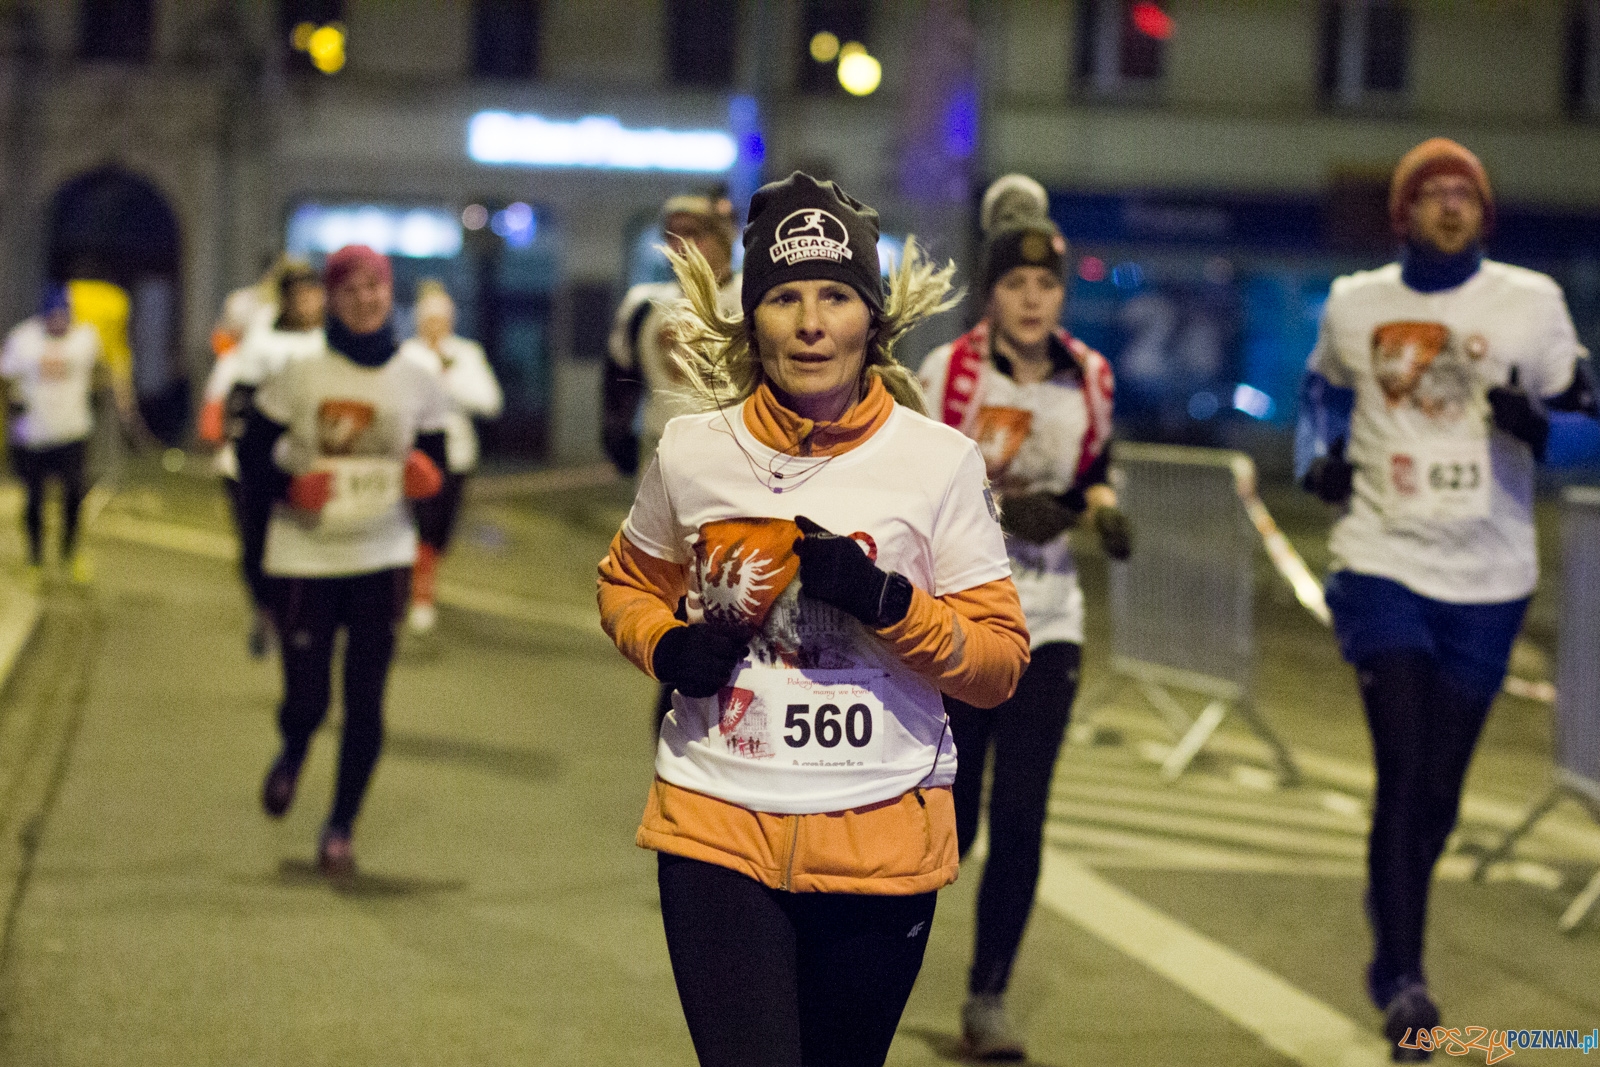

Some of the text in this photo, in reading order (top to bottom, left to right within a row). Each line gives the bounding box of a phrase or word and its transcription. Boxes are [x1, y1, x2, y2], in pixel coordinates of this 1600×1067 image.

[789, 248, 839, 262] JAROCIN
[1428, 463, 1480, 491] 623
[813, 690, 835, 700] mamy
[783, 703, 873, 749] 560
